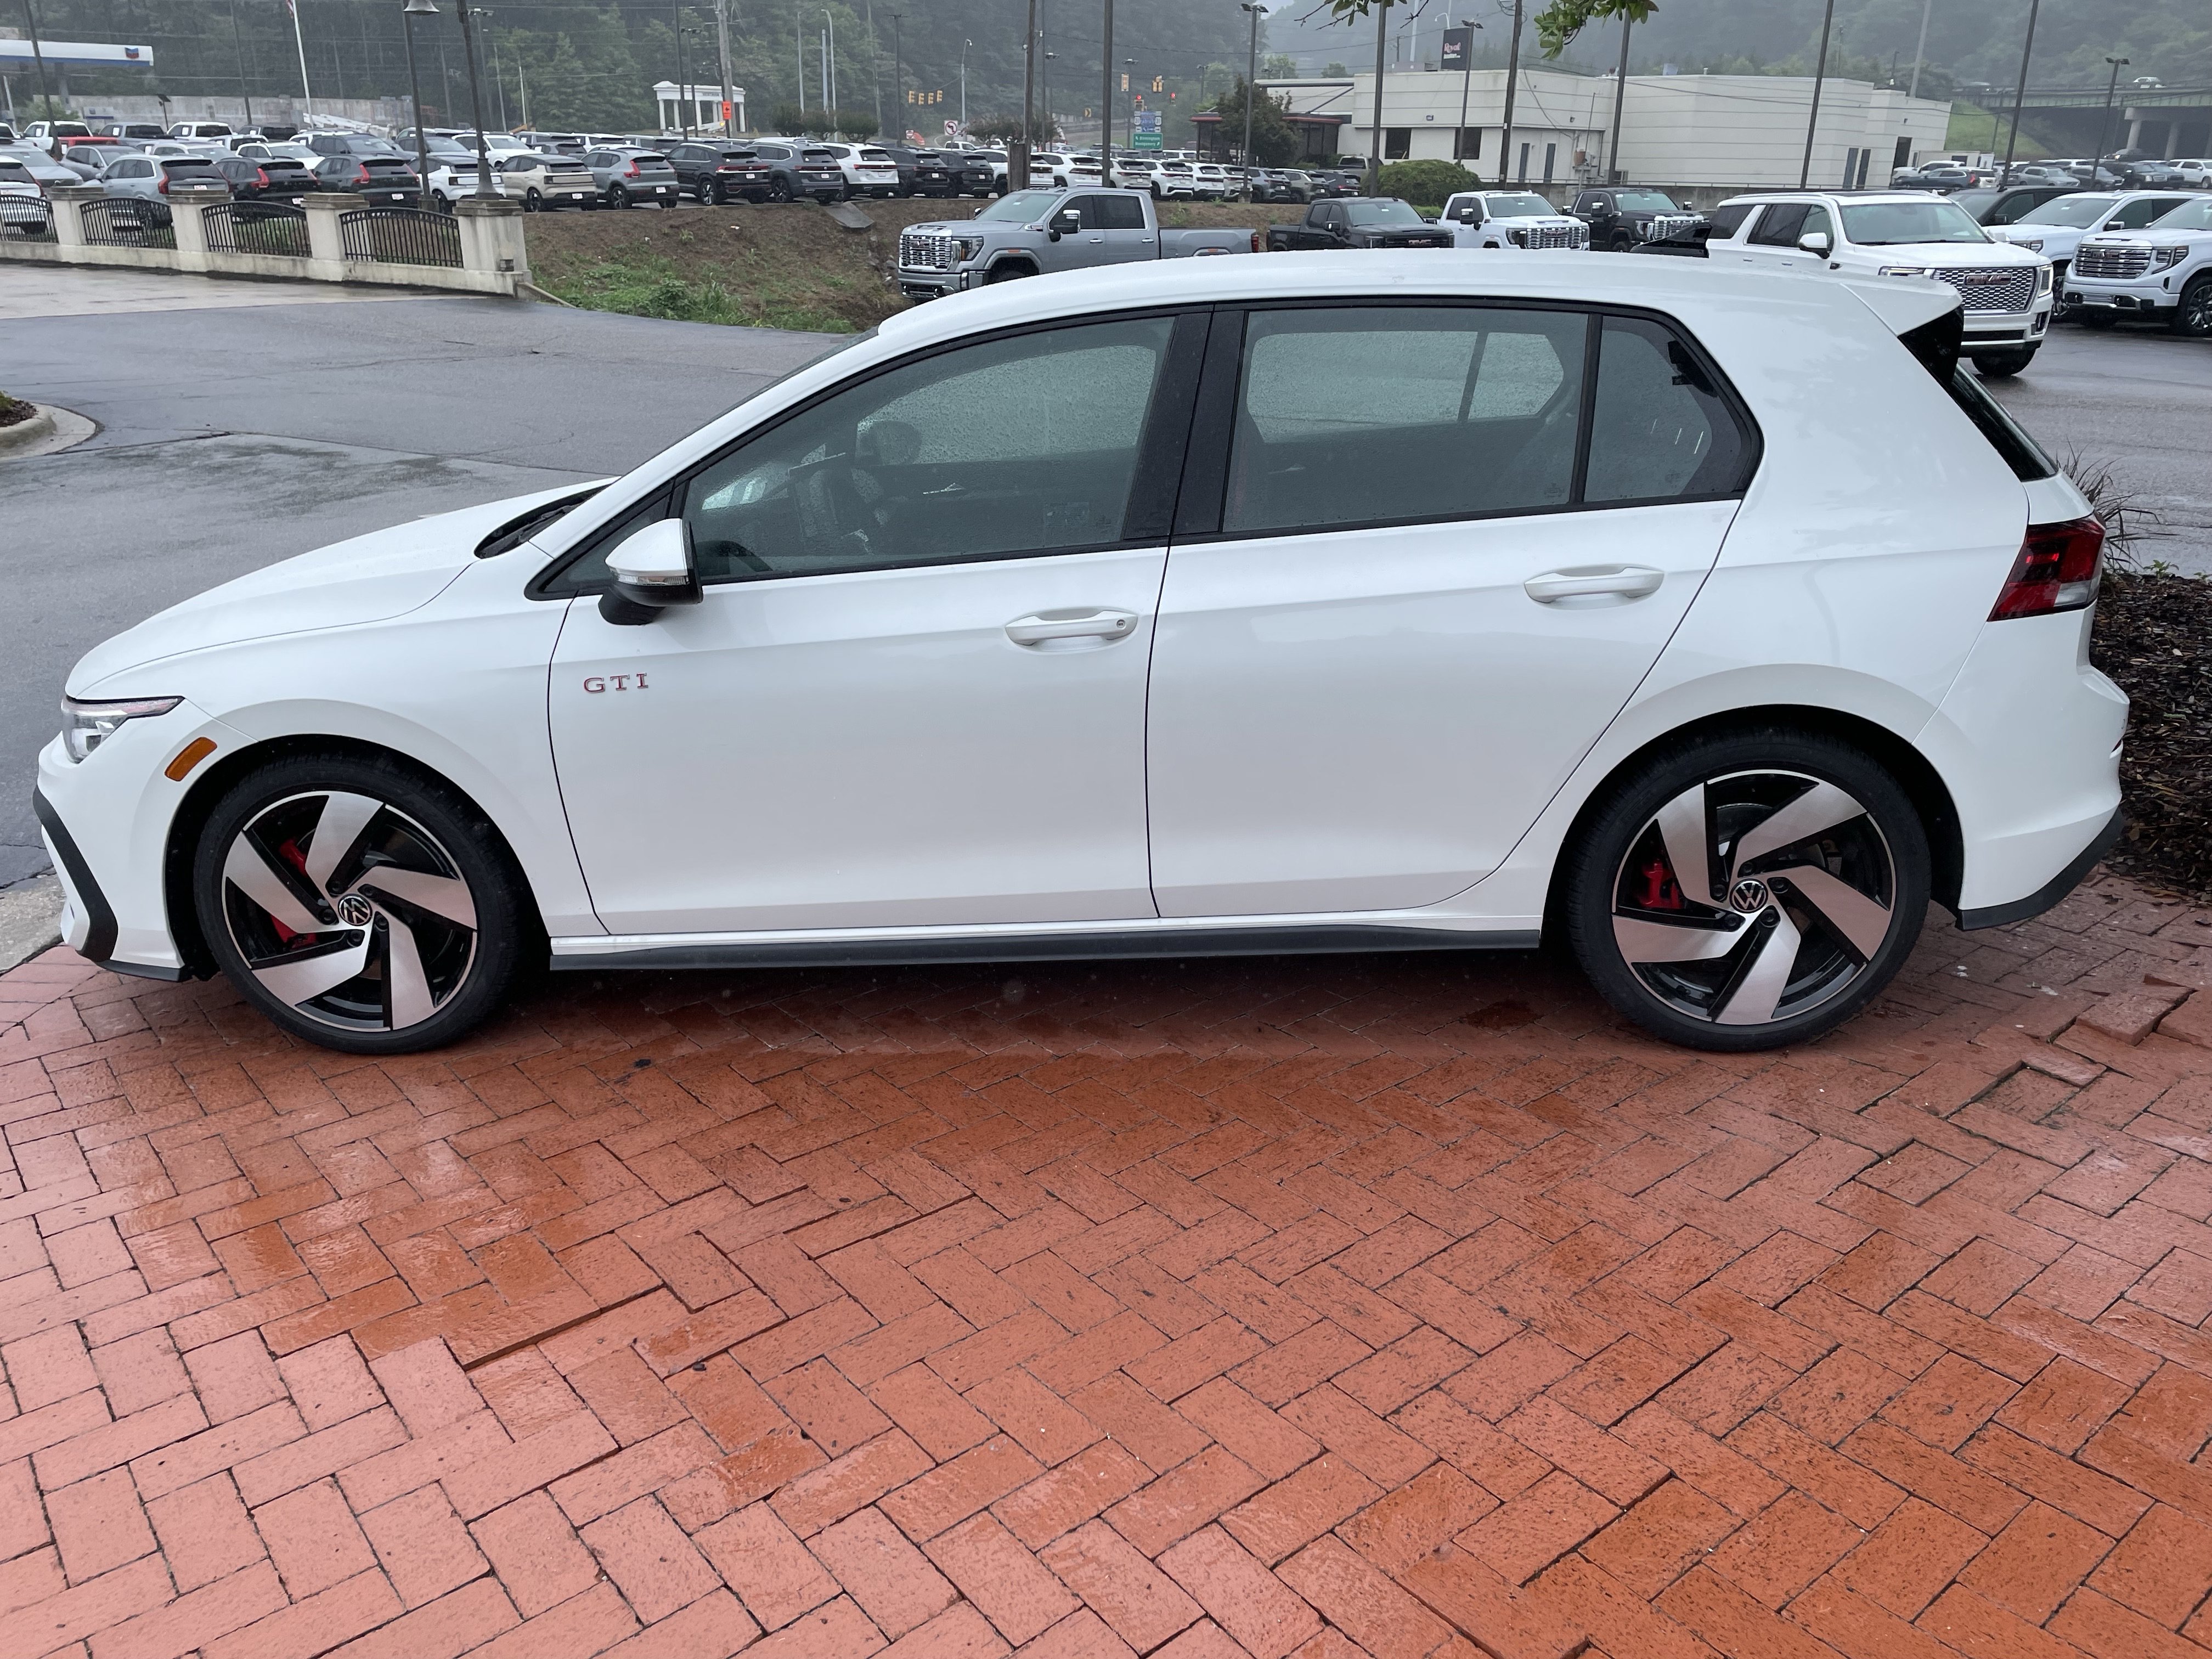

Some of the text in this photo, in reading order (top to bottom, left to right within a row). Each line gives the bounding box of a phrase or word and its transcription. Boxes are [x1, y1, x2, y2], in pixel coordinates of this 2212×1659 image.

[1444, 42, 1461, 53] Royal
[1966, 275, 2011, 285] GMC
[583, 673, 648, 693] GTI
